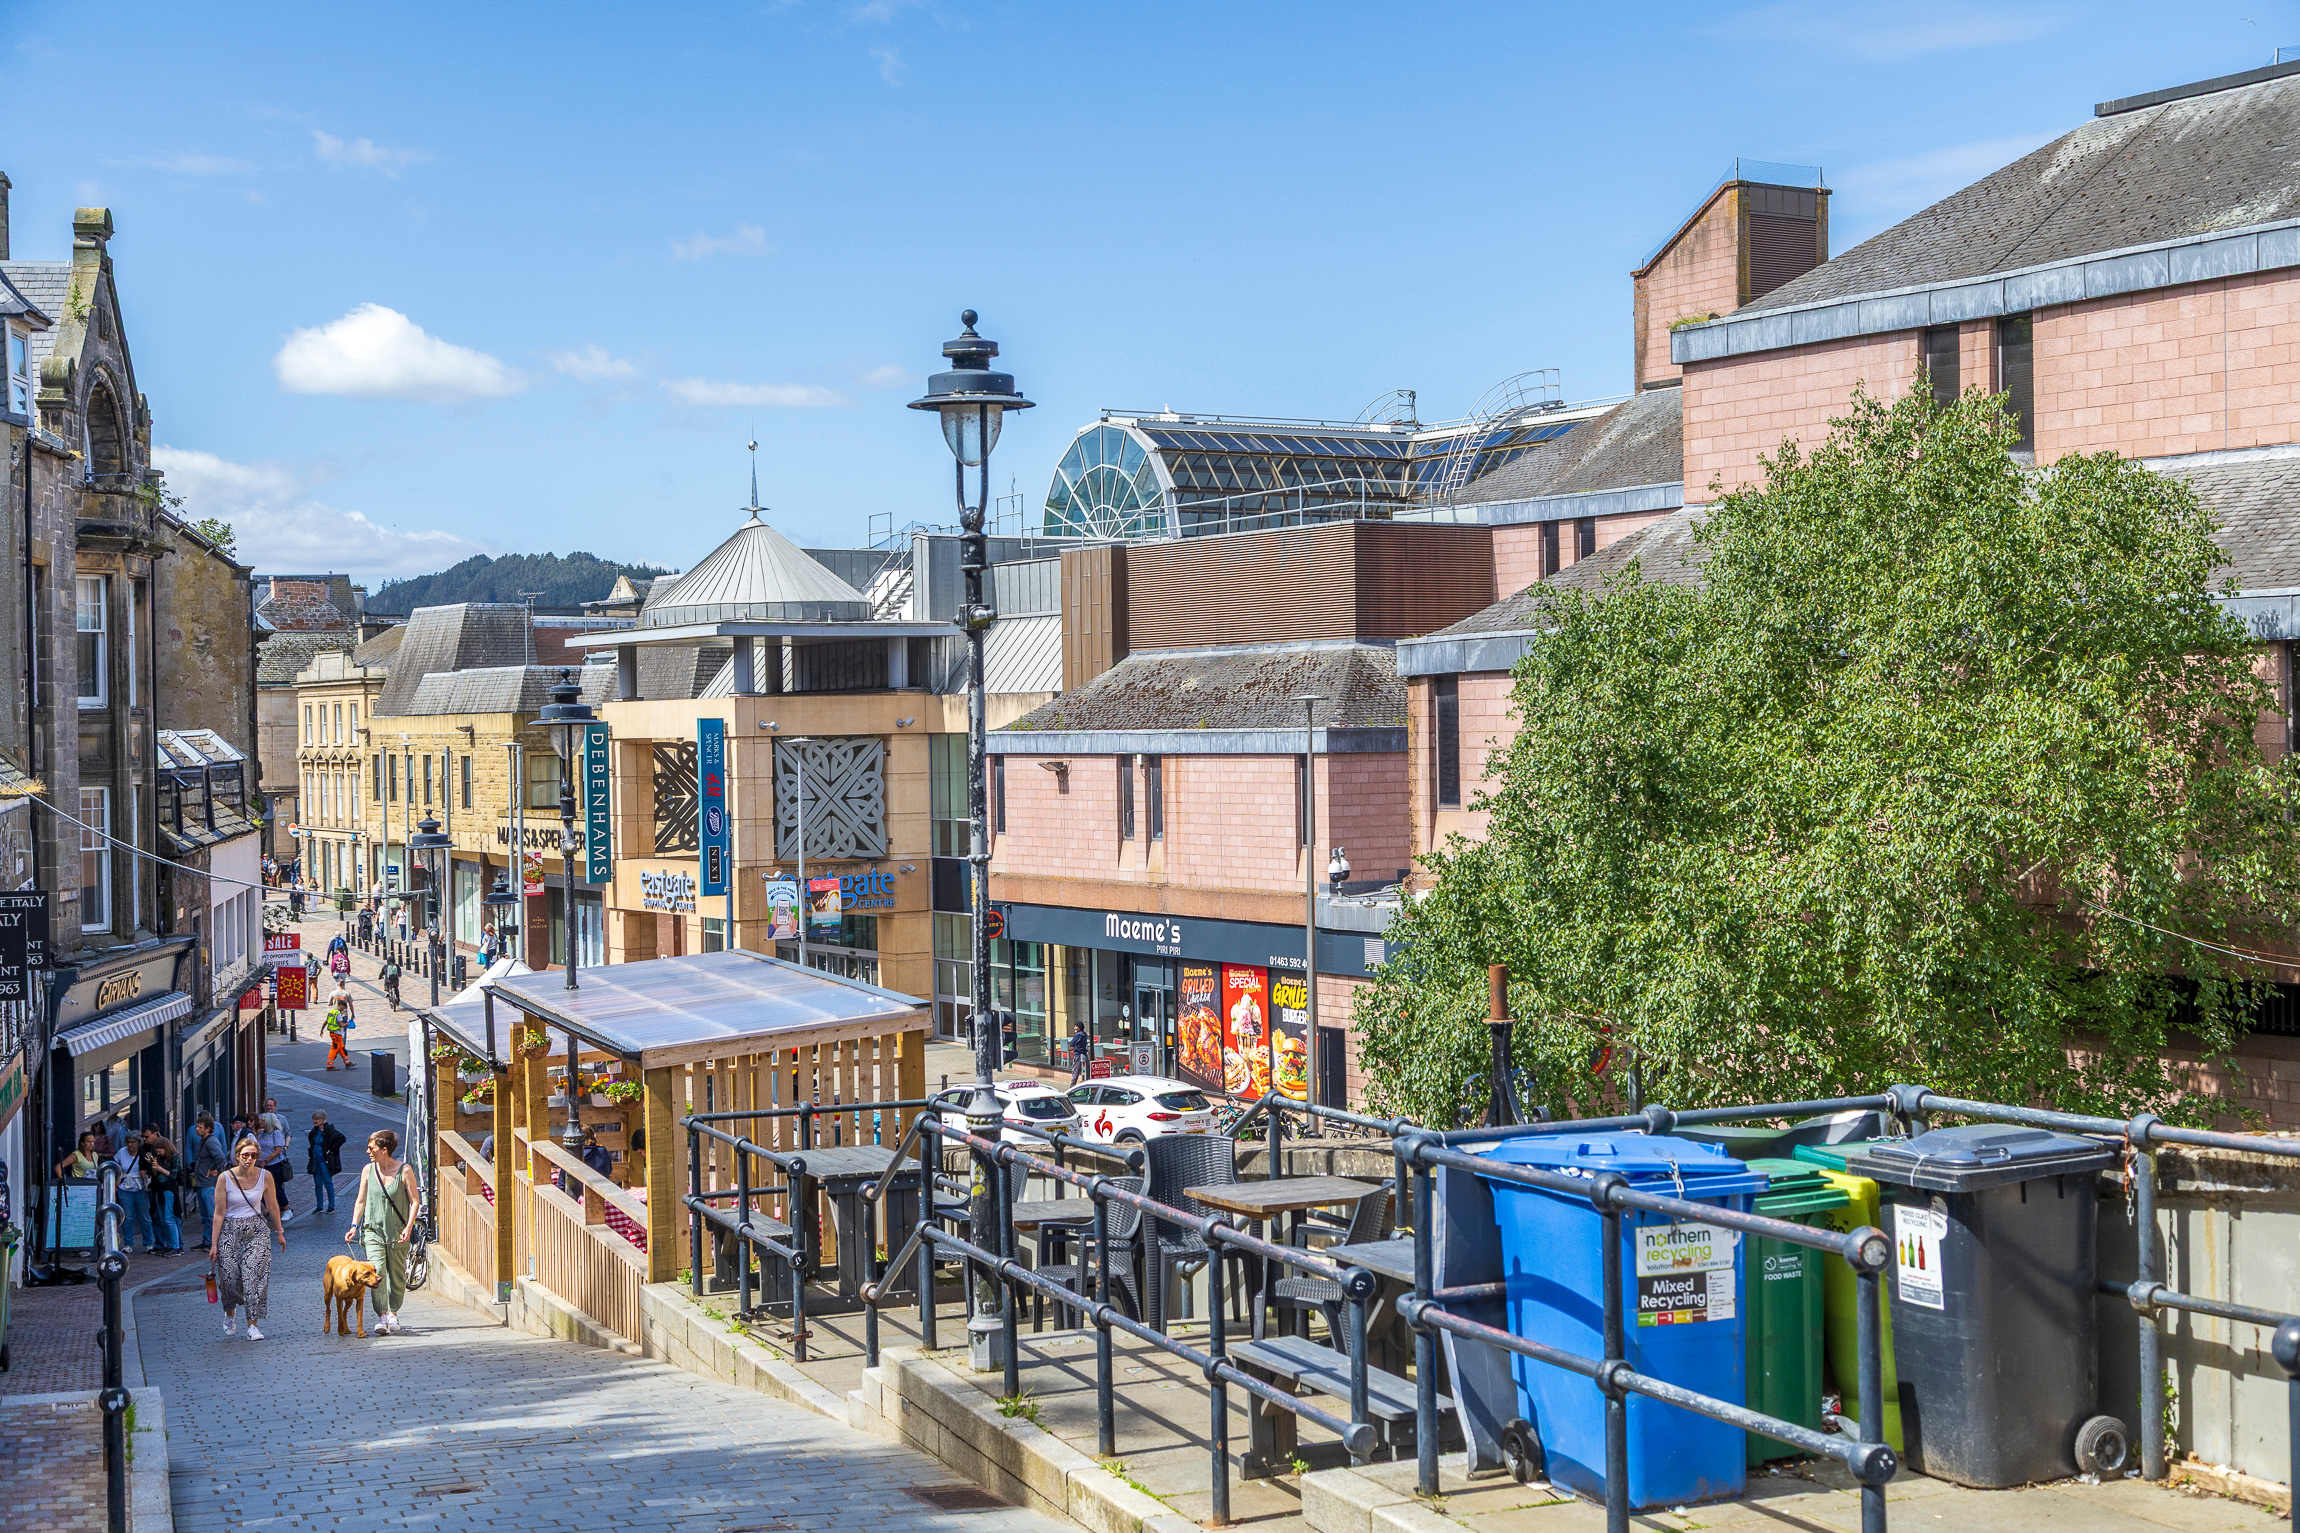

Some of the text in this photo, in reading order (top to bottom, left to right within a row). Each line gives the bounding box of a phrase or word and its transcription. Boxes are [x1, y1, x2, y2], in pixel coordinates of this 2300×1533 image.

[591, 733, 607, 875] DEBENHAMS
[709, 810, 721, 833] Boots
[711, 848, 719, 881] NEXT
[640, 869, 697, 910] eastgate
[12, 896, 45, 908] ITALY
[858, 899, 896, 909] CENTRE
[1105, 912, 1181, 944] Maeme's
[268, 935, 292, 949] SALE
[1156, 944, 1181, 956] PIRI PIRI
[1269, 955, 1288, 967] 01463
[1289, 957, 1301, 968] 592
[1184, 967, 1213, 977] Maeme's
[1182, 978, 1215, 994] GRILLED
[1229, 976, 1260, 989] SPECIAL
[1272, 982, 1307, 1010] GRILLE
[1646, 1229, 1711, 1247] northern
[1646, 1243, 1712, 1262] recycling
[1764, 1270, 1802, 1280] FOOD WASTE
[1652, 1277, 1694, 1294] Mixed
[1640, 1291, 1706, 1310] Recycling
